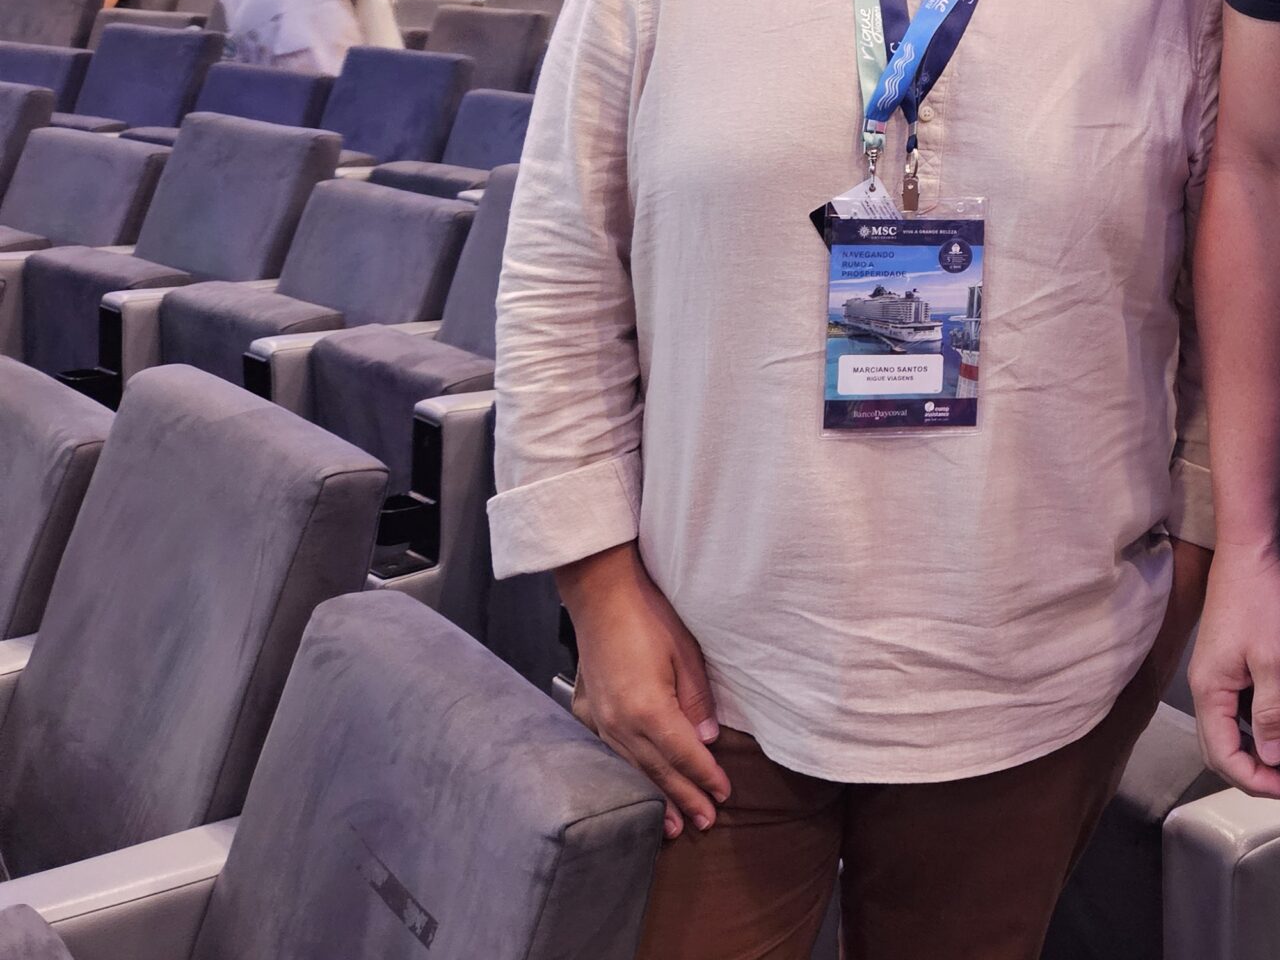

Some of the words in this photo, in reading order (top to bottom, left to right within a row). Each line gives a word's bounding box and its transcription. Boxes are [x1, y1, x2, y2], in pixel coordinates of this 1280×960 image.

[859, 7, 882, 60] rigue
[871, 226, 897, 236] MSC
[841, 270, 907, 278] PROSPERIDADE
